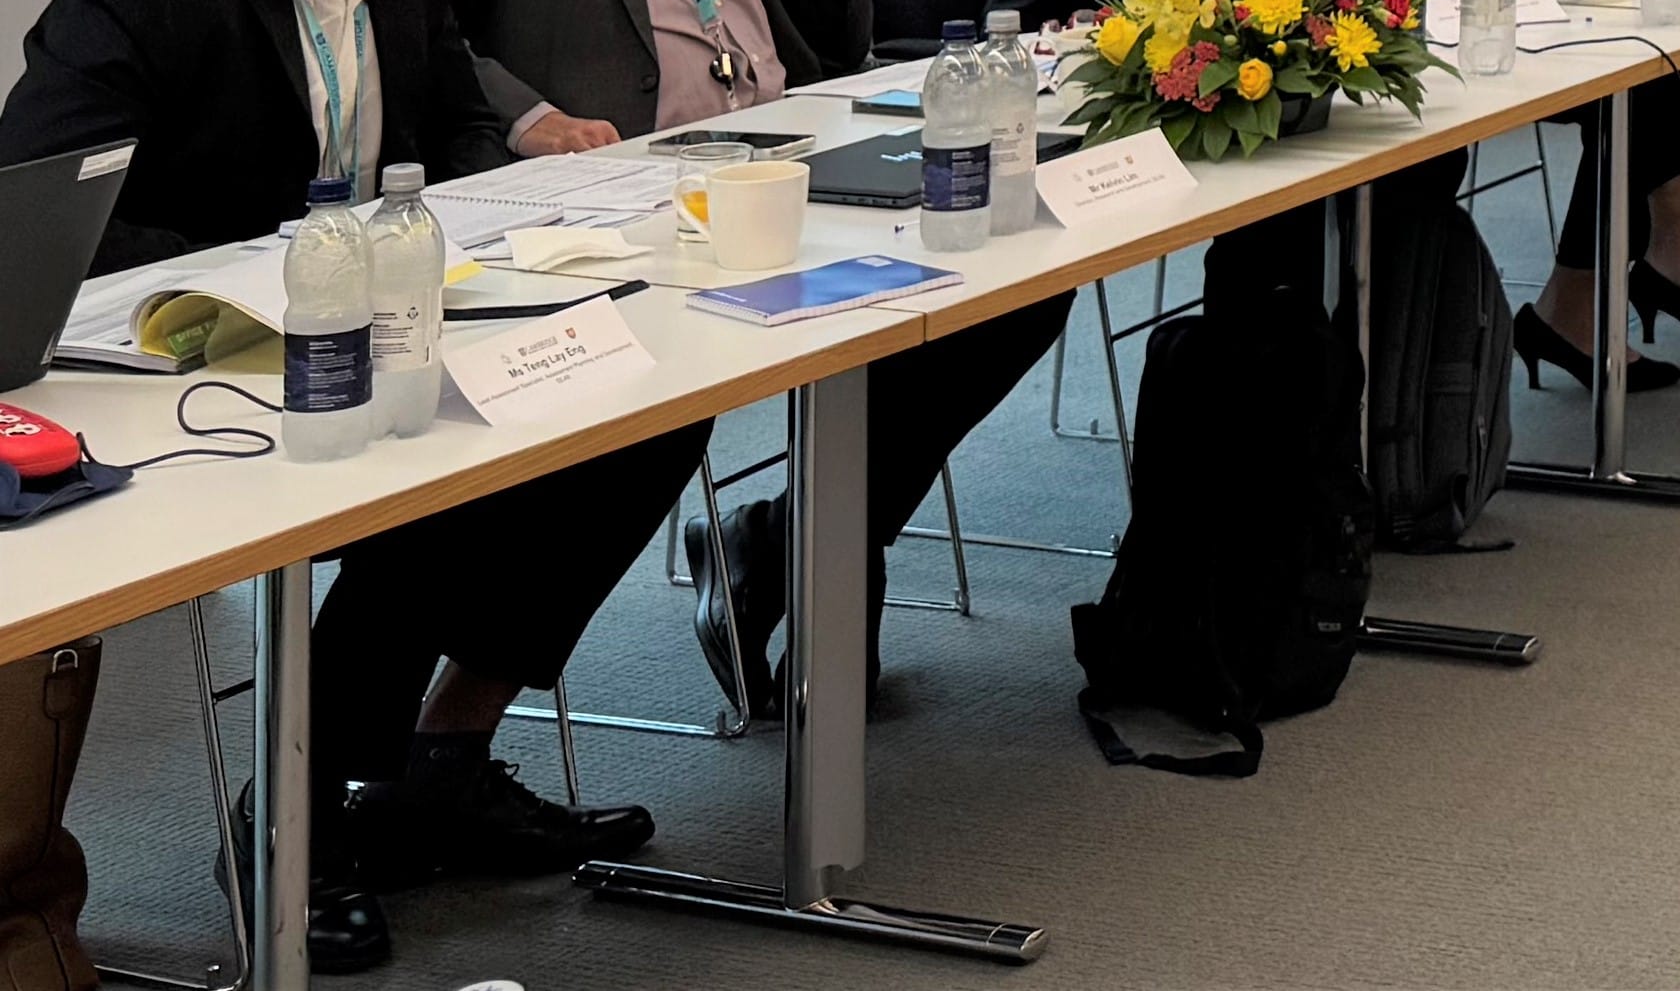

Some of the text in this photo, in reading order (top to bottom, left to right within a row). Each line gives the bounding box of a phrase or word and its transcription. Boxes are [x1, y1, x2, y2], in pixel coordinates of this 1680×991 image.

[507, 344, 586, 379] Ms Teng Lay Eng
